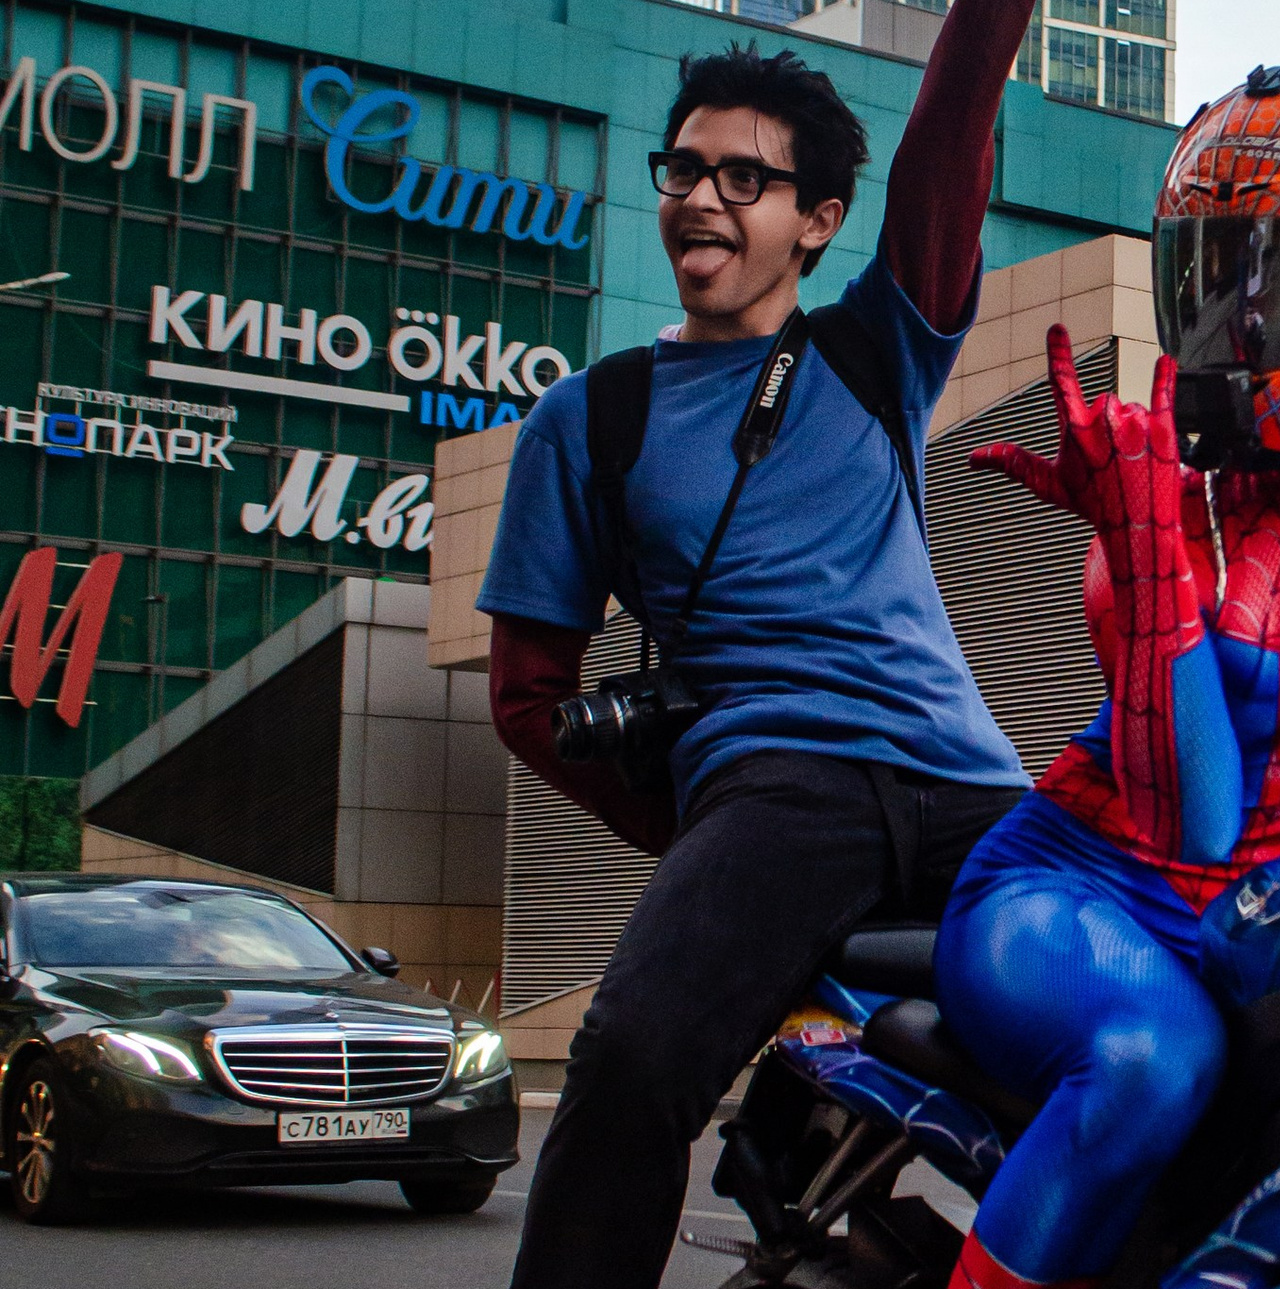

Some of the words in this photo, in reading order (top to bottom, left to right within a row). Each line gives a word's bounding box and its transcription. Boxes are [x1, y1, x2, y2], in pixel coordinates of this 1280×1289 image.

[301, 65, 590, 250] Сити
[149, 285, 373, 371] КИНО
[760, 353, 794, 408] Canon
[374, 1112, 404, 1128] 790
